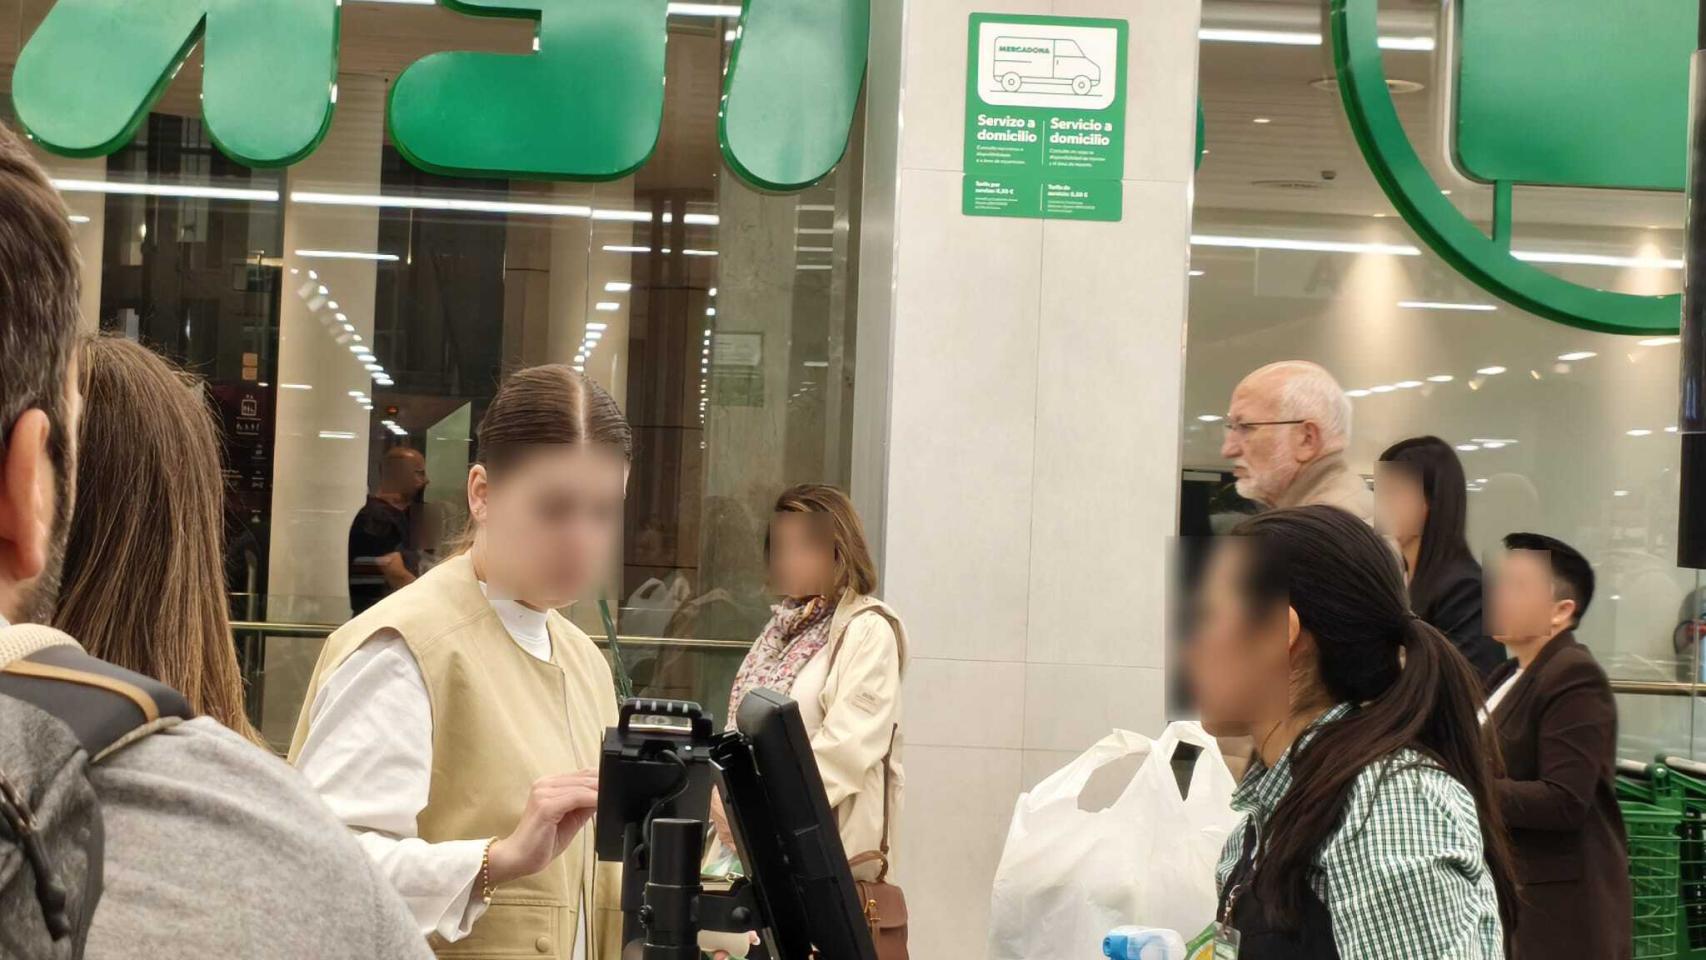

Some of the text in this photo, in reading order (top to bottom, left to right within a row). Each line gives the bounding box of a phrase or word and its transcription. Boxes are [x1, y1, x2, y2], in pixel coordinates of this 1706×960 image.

[999, 46, 1050, 54] MERCADONA
[977, 114, 1036, 129] Servizo a
[1050, 117, 1113, 132] Servicio a
[977, 128, 1037, 142] domicilio
[1049, 131, 1110, 146] domicilio
